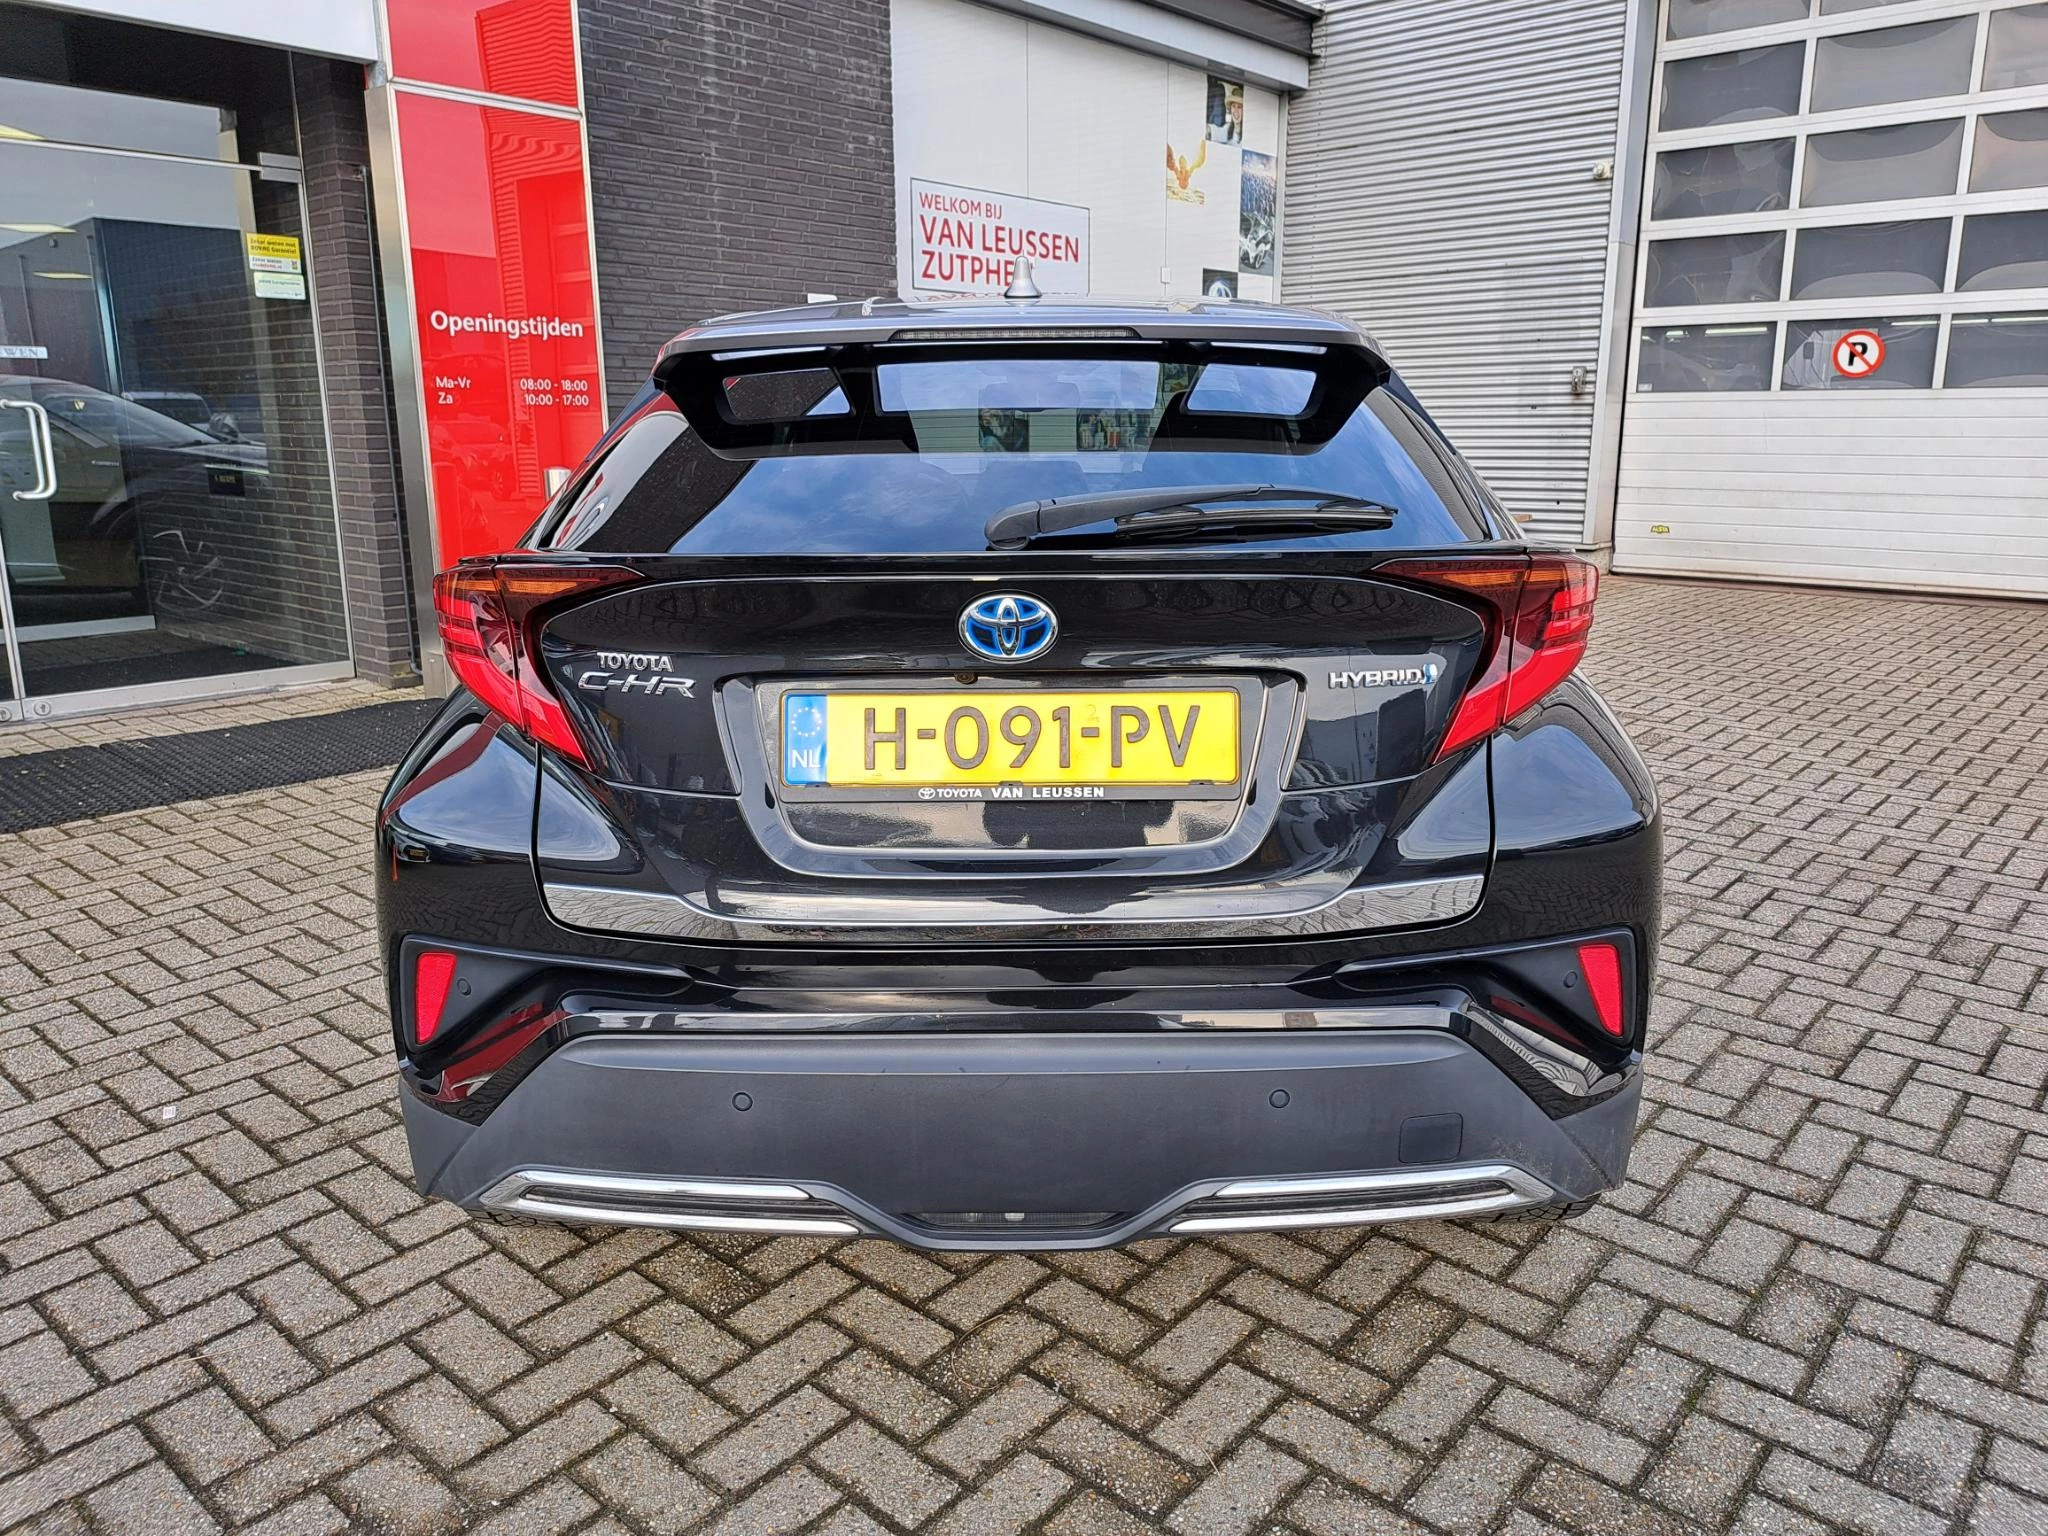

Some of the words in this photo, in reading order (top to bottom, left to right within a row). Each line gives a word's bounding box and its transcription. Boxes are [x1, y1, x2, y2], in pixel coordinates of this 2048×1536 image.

[919, 191, 982, 217] WELKOM
[985, 203, 1003, 220] BIJ
[919, 214, 974, 250] VAN
[981, 223, 1080, 264] LEUSSEN
[921, 249, 1034, 288] ZUTPHE
[430, 310, 584, 341] Openingstijden
[0, 347, 39, 356] WEN
[435, 376, 471, 389] Ma-Vr
[520, 378, 551, 391] 08:00
[561, 379, 588, 391] 18:00
[438, 392, 454, 405] Za
[524, 394, 553, 405] 10:00
[562, 394, 589, 406] 17:00
[597, 652, 674, 672] TOYOTA
[578, 671, 696, 698] C-HR
[1329, 668, 1424, 688] HYBRID
[864, 705, 1200, 770] H-091-PV
[792, 749, 821, 768] NL
[937, 788, 982, 798] TOYOTA
[992, 787, 1023, 798] VAN
[1033, 787, 1104, 798] LEUSSEN
